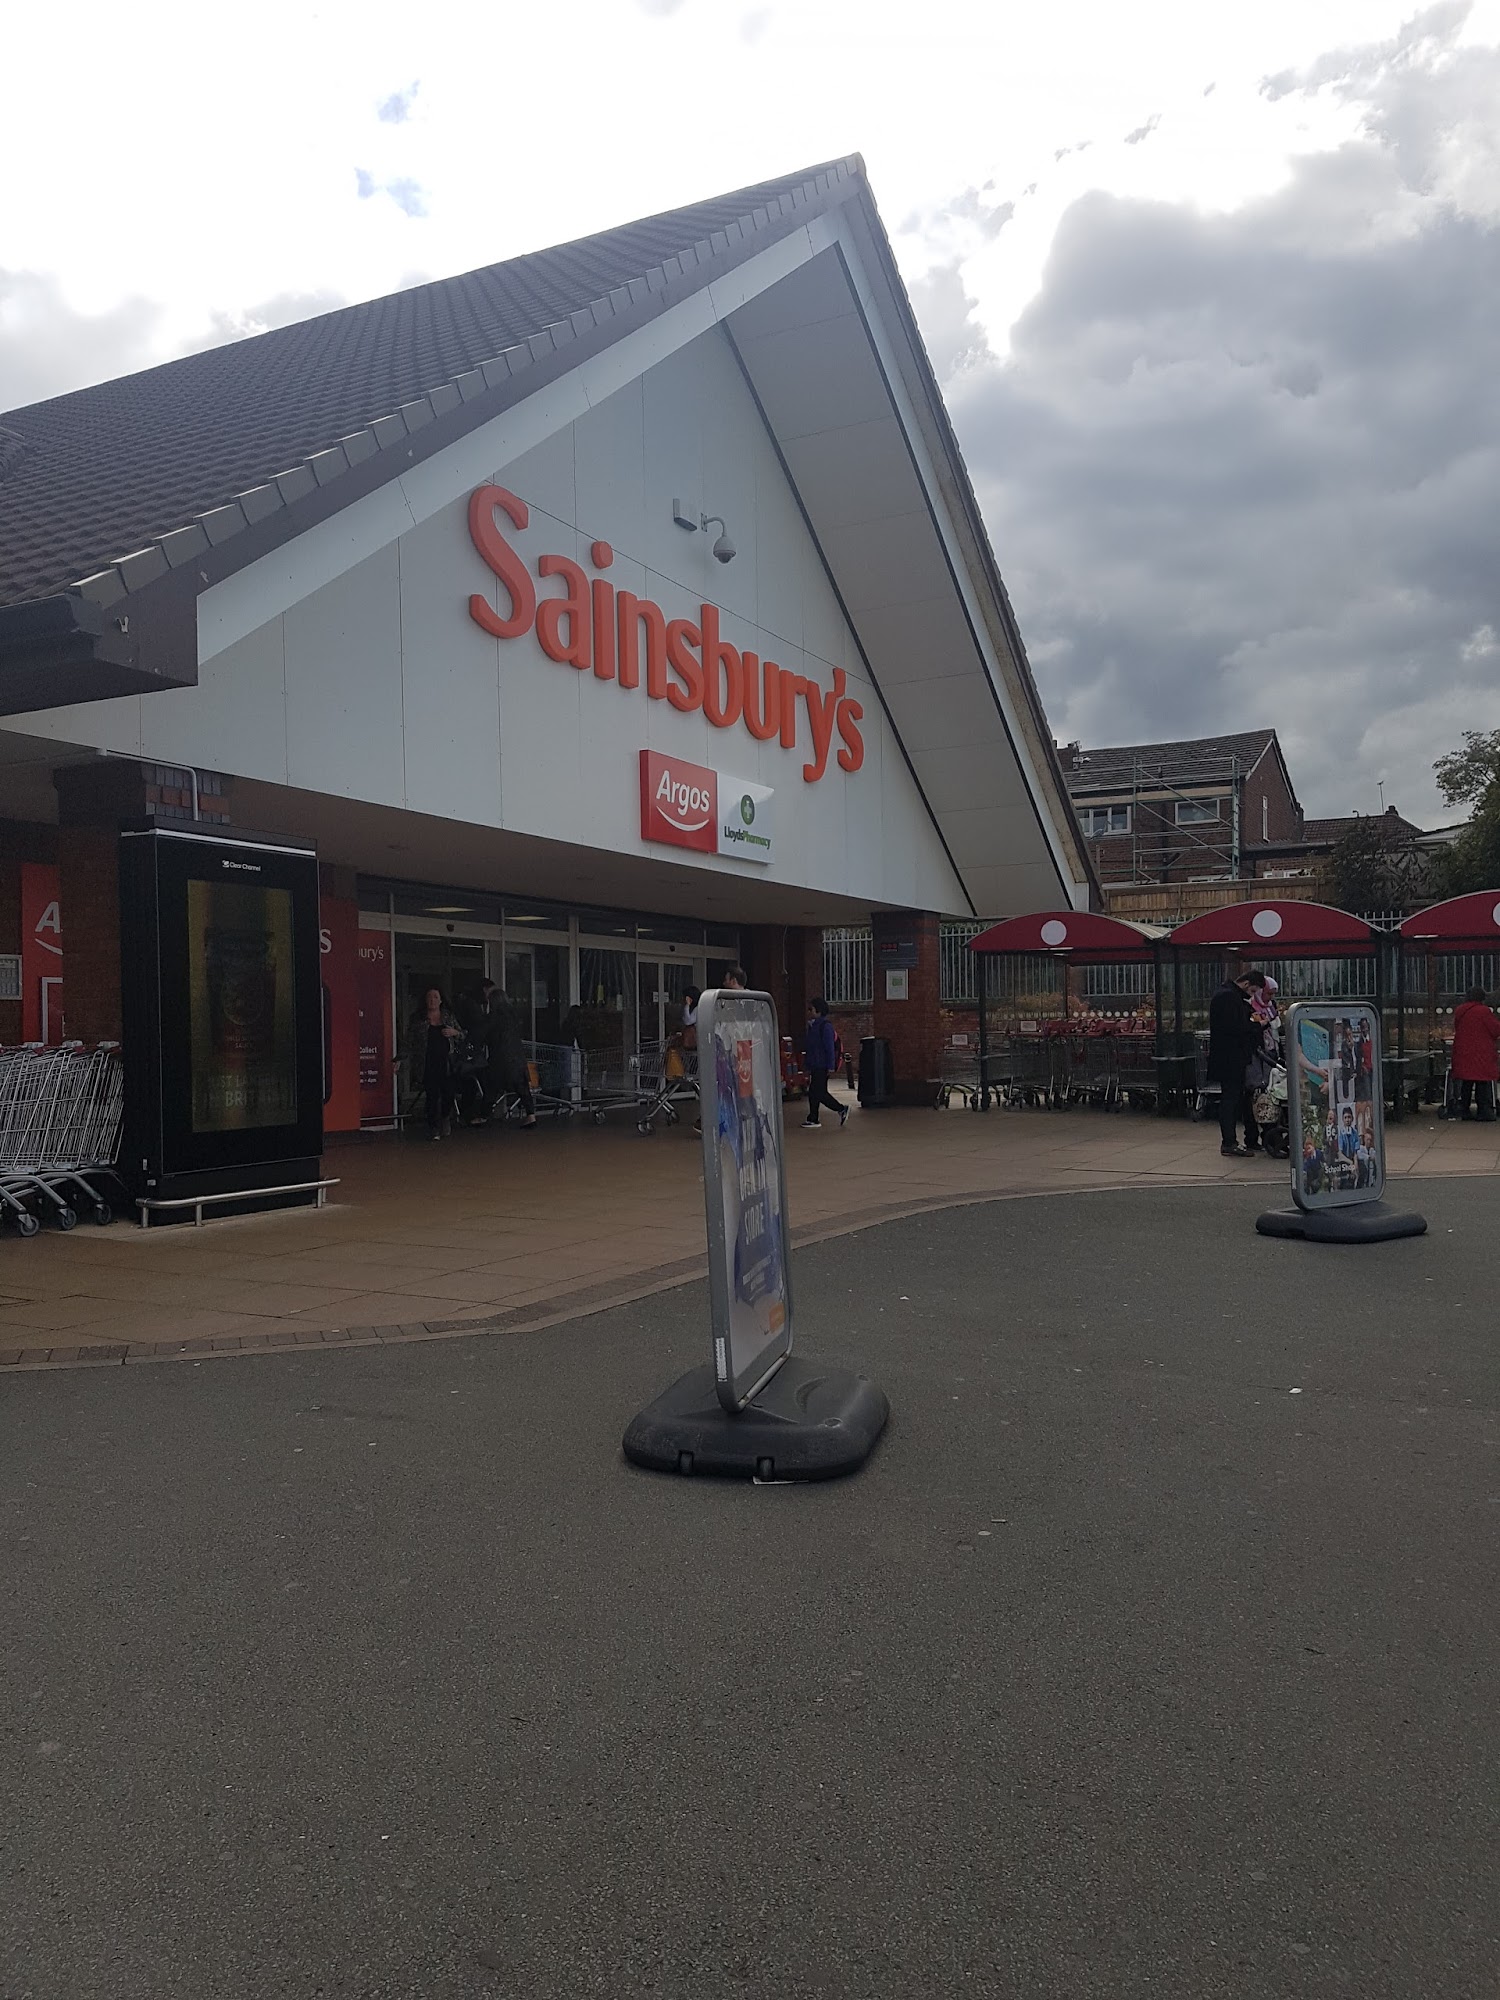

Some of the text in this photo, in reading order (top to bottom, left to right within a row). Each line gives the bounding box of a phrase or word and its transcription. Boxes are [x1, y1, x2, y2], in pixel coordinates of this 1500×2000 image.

[469, 485, 864, 783] Sainsbury's
[656, 770, 710, 816] Argos
[724, 826, 771, 850] LloydsPharmacy
[35, 902, 63, 933] A
[358, 946, 384, 962] ury's
[1324, 1163, 1341, 1174] School
